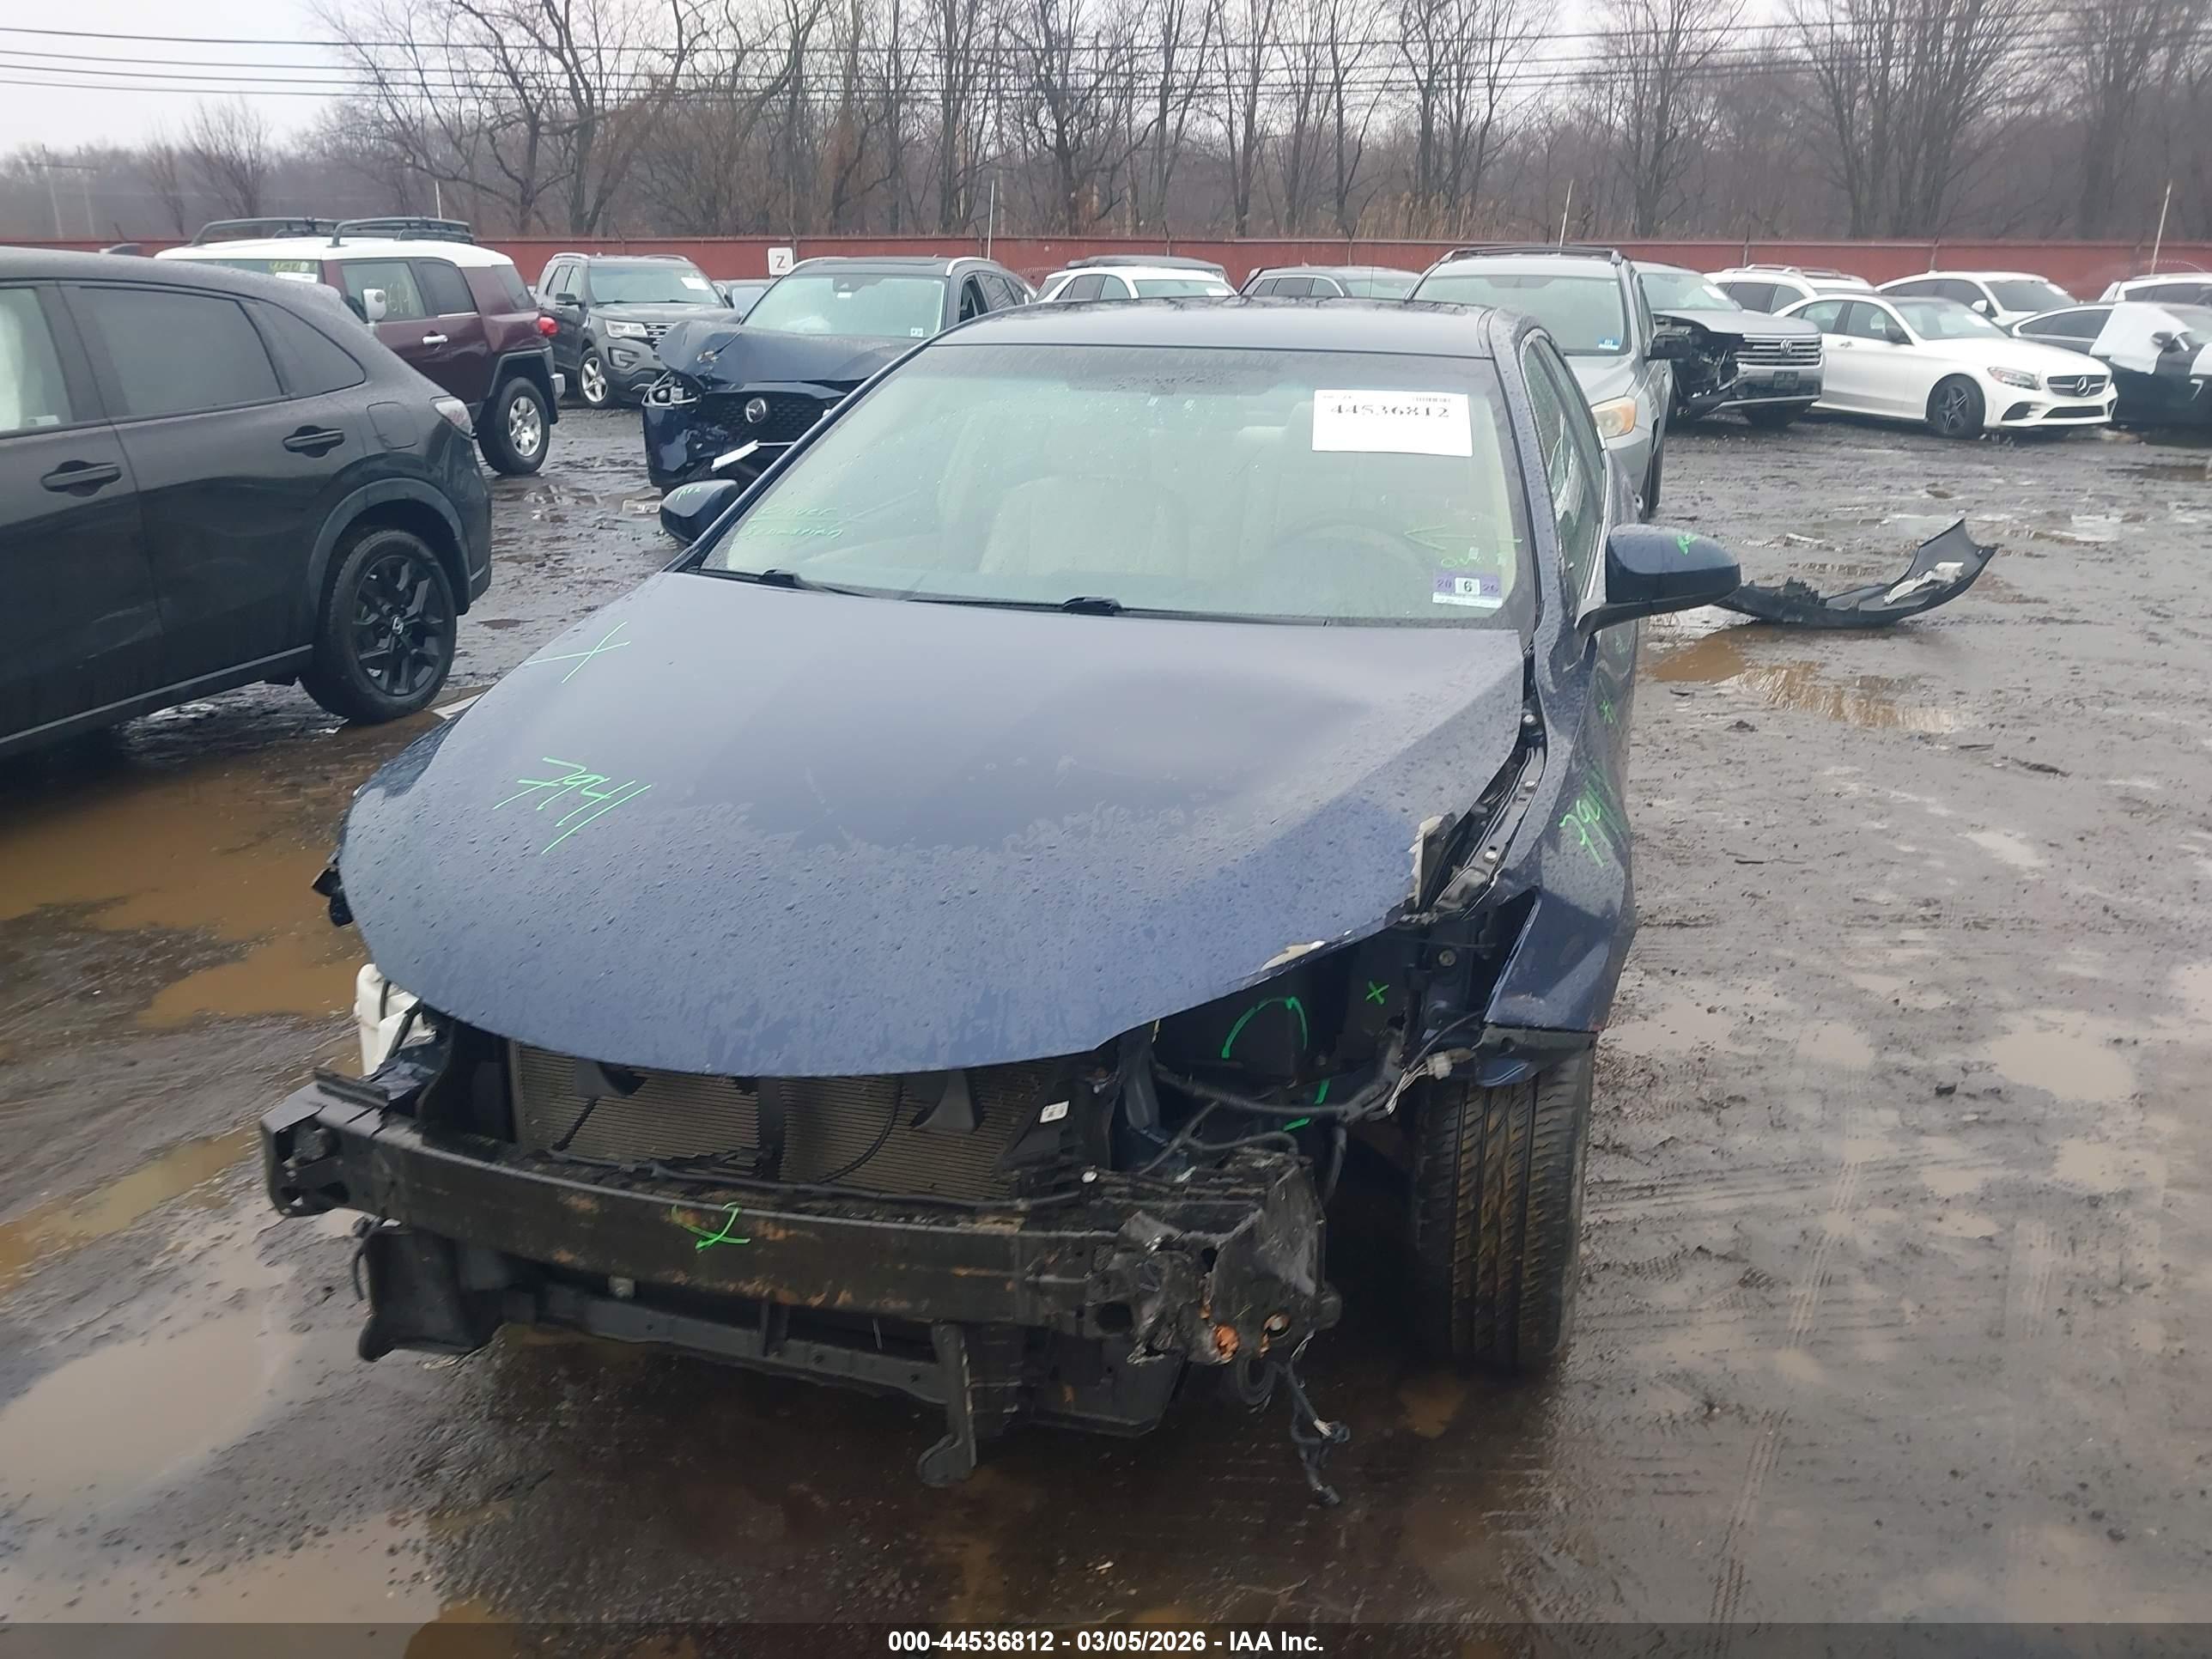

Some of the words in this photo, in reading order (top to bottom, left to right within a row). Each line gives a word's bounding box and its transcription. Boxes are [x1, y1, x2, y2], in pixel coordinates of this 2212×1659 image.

[775, 254, 787, 269] Z
[1330, 404, 1450, 418] 44536812
[1463, 580, 1474, 592] 6
